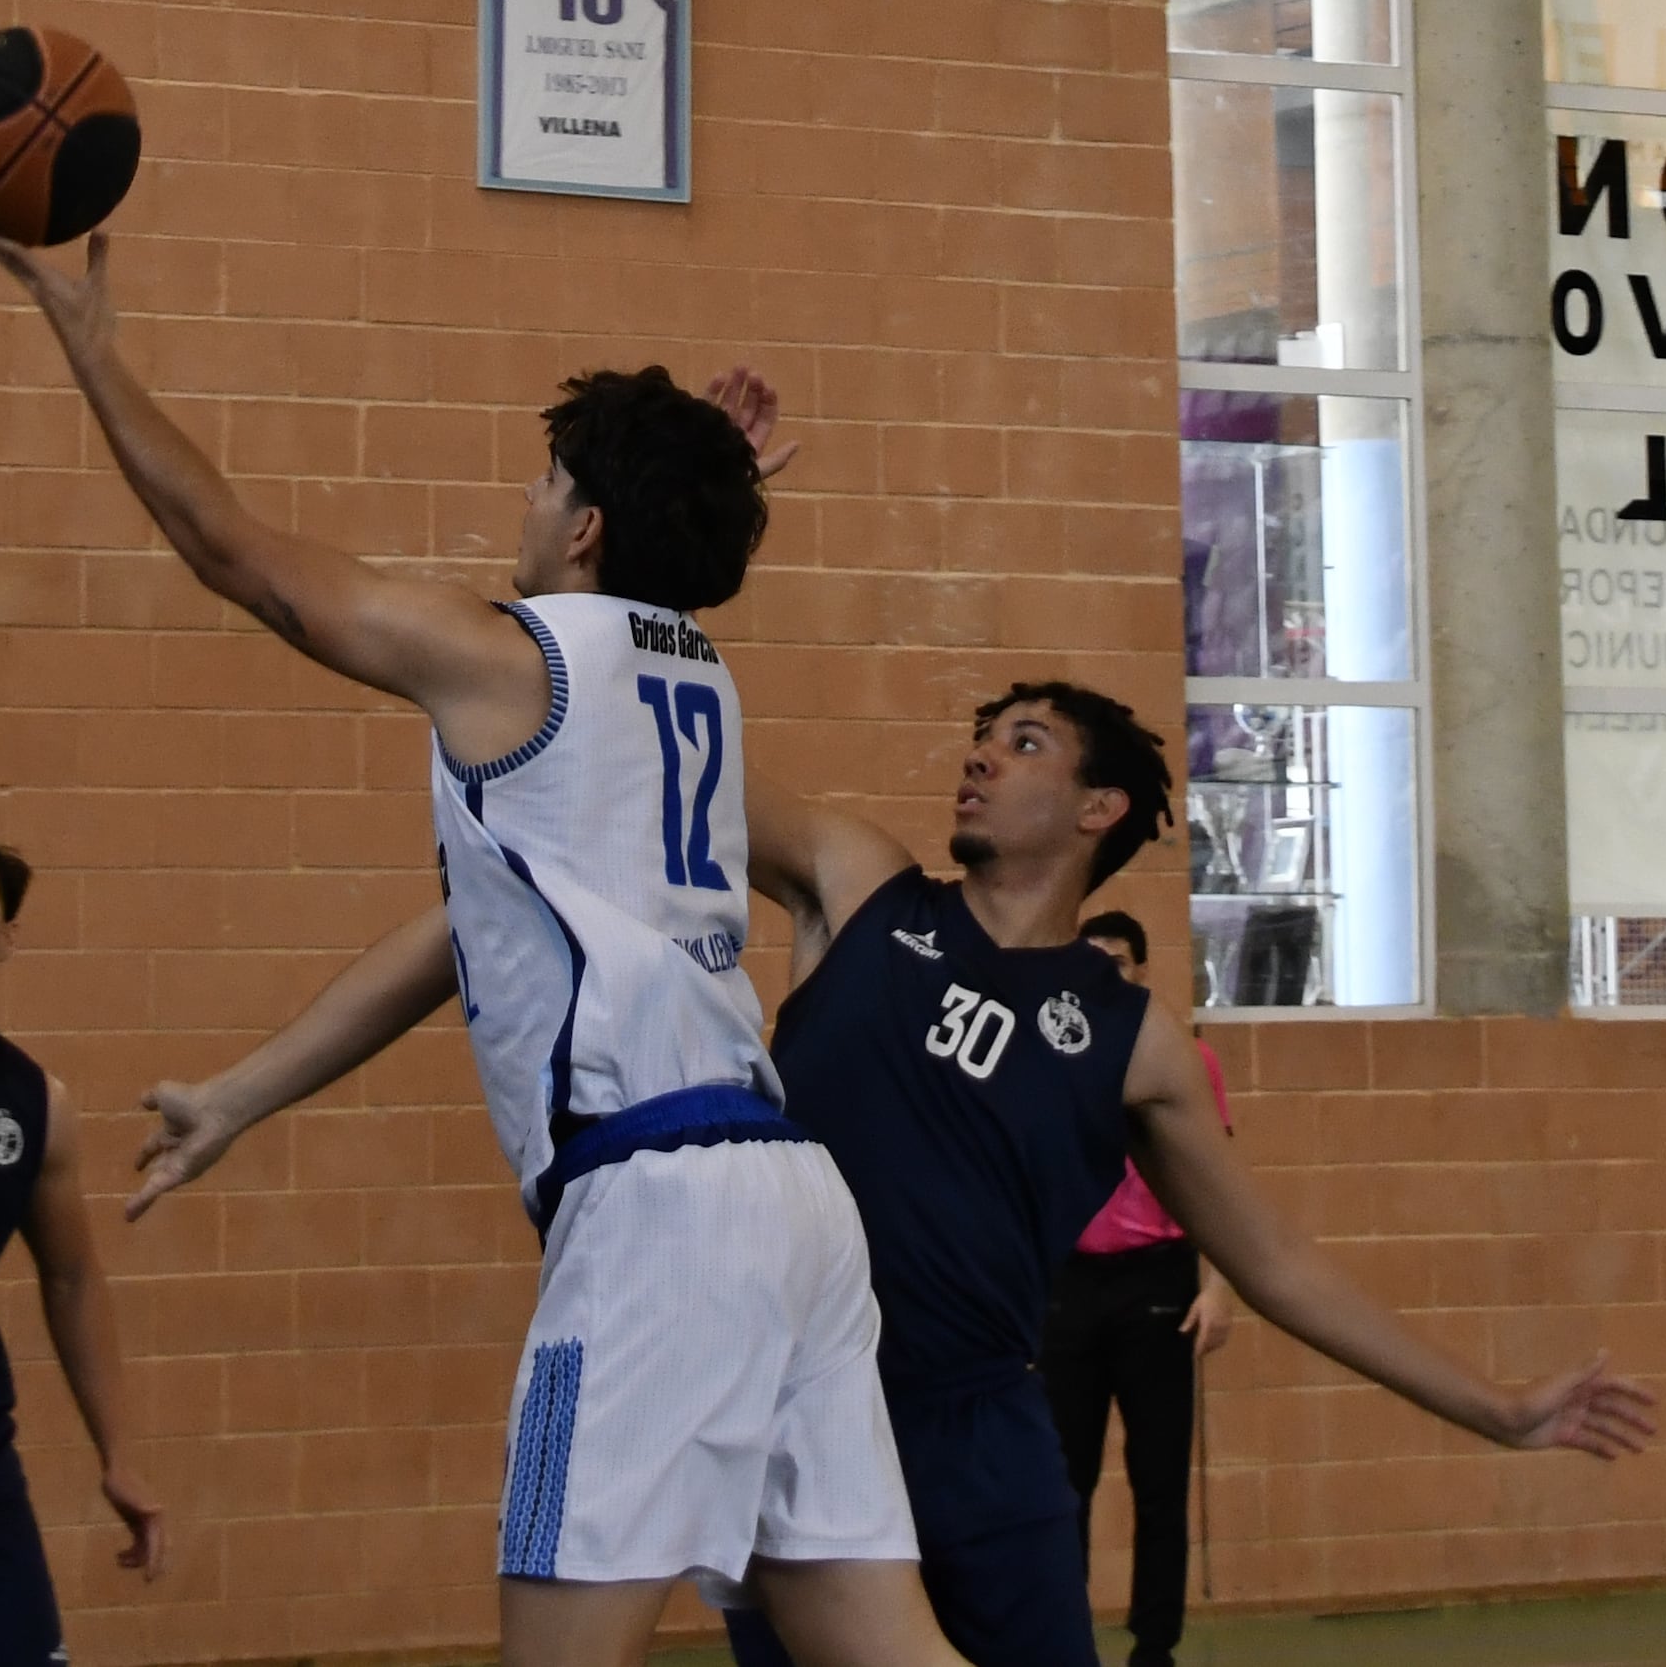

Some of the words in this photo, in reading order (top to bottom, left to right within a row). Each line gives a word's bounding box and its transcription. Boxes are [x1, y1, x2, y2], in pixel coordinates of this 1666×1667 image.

[539, 116, 622, 138] VILLENA
[628, 611, 676, 656] Grúas
[636, 673, 733, 892] 12
[925, 983, 1016, 1078] 30
